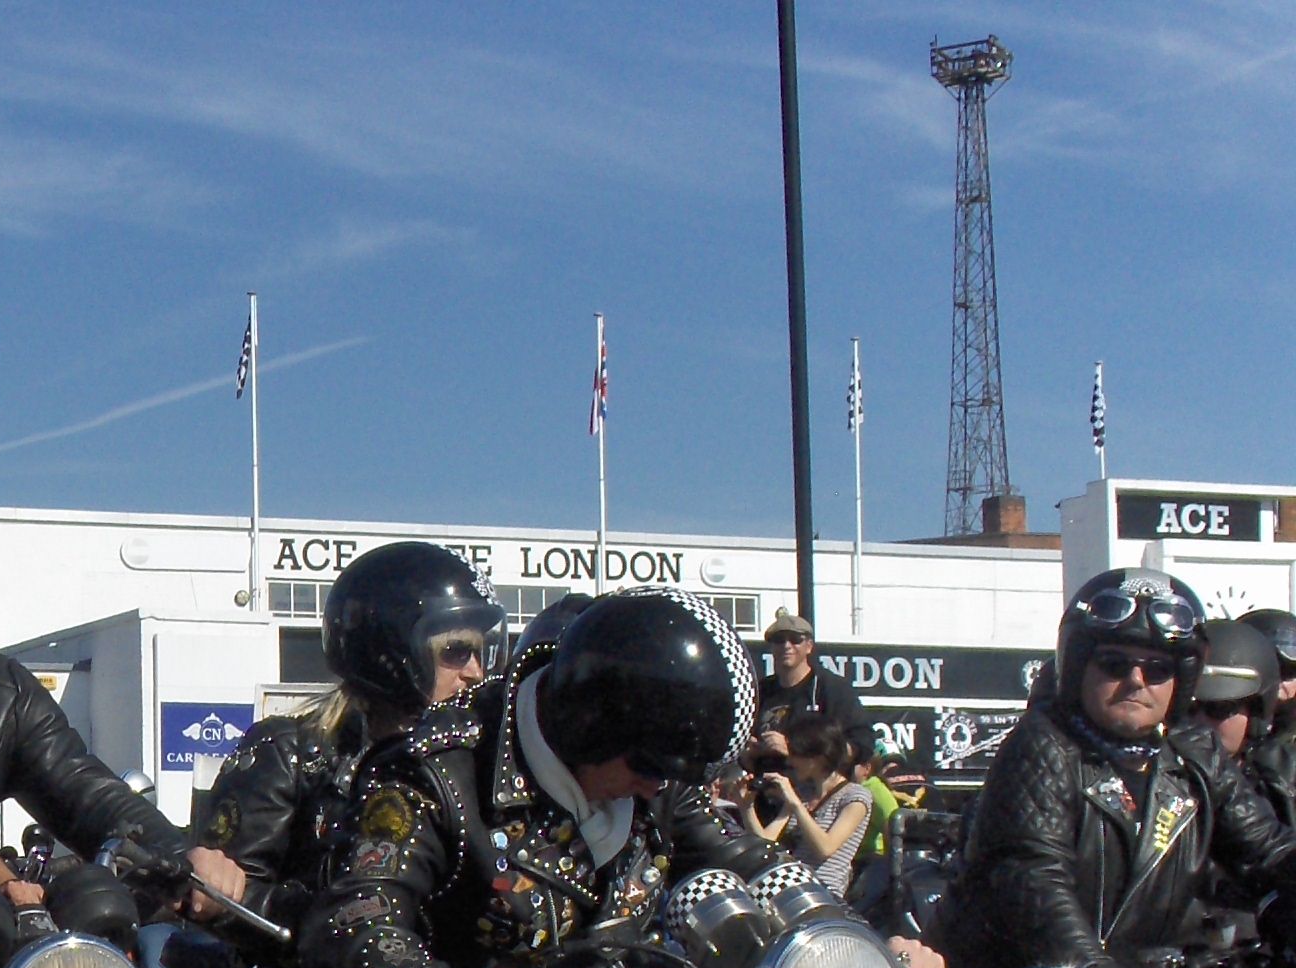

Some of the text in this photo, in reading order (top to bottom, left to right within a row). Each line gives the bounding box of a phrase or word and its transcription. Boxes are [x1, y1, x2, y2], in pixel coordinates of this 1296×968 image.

[1156, 502, 1230, 535] ACE
[273, 538, 357, 571] ACE
[520, 546, 683, 583] LONDON
[762, 653, 944, 689] NDON
[202, 728, 221, 740] CN
